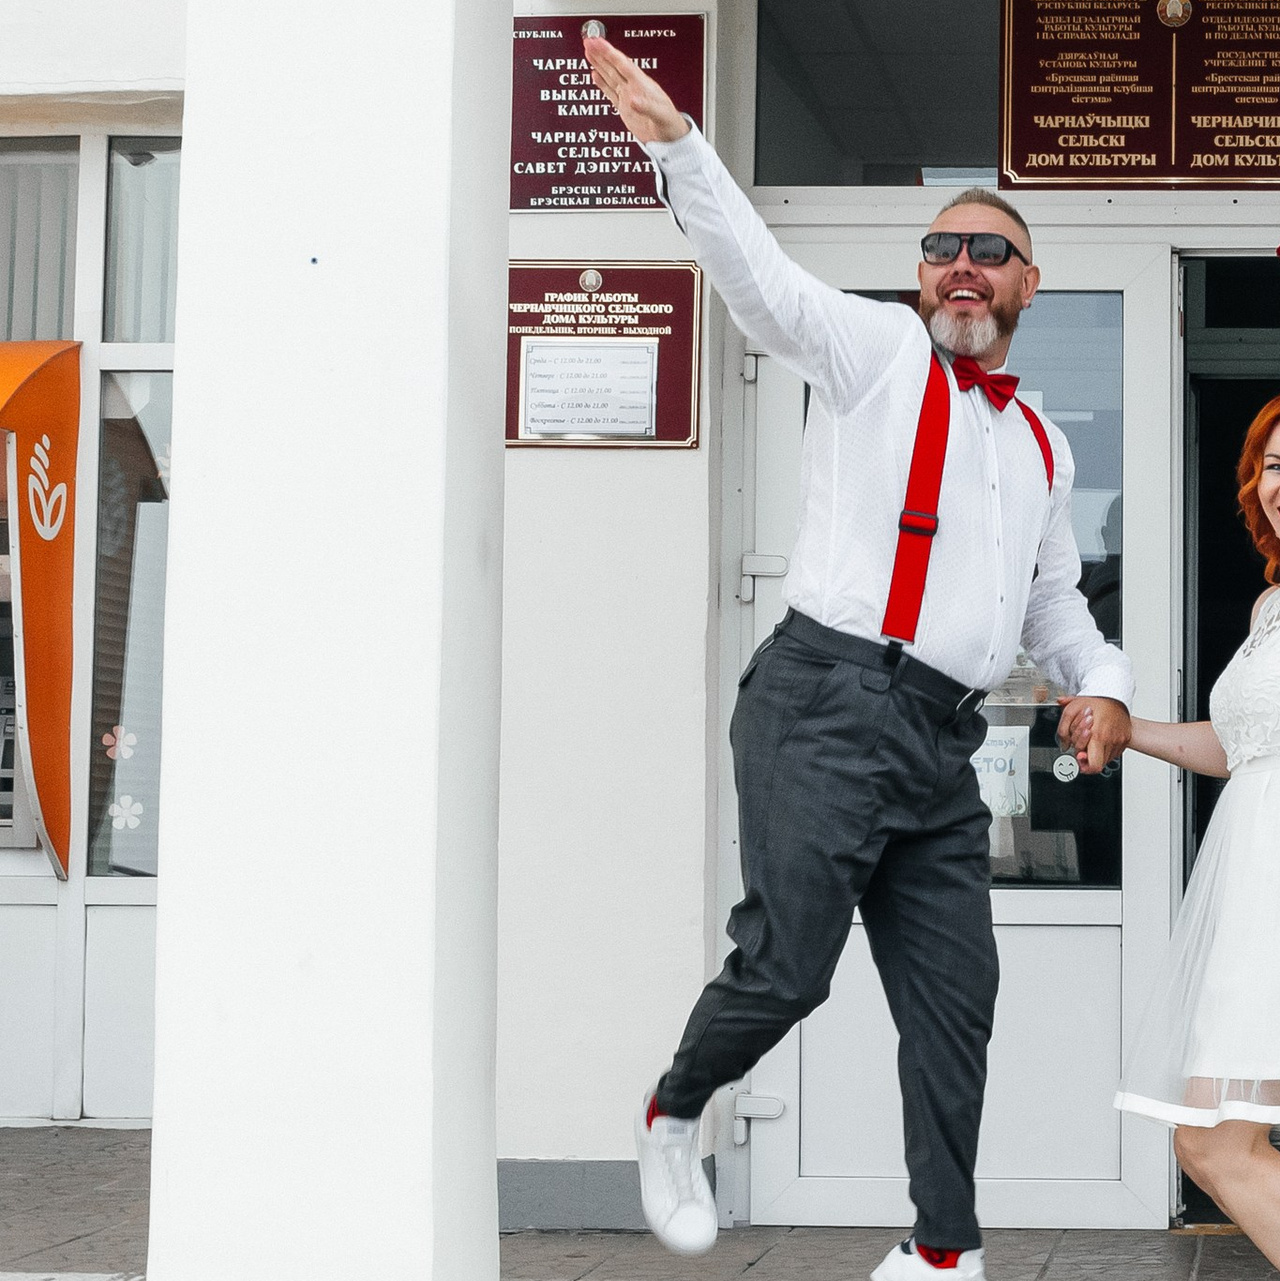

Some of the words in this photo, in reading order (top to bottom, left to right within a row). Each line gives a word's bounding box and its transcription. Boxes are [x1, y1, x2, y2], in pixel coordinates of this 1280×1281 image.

[1093, 2, 1141, 10] БЕЛАРУСЬ
[1206, 2, 1268, 10] РЕСПУБЛИКИ
[1202, 16, 1232, 24] ОТДЕЛ
[1085, 24, 1133, 32] КУЛЬТУРЫ
[513, 30, 564, 39] СПУБЛІКА
[624, 29, 677, 38] БЕЛАРУСЬ
[1042, 32, 1056, 40] ПА
[1057, 32, 1098, 40] СПРАВАХ
[1205, 32, 1212, 40] И
[1214, 32, 1228, 40] ПО
[1229, 32, 1262, 40] ДЕЛАМ
[1204, 59, 1268, 68] УЧРЕЖДЕНИЕ
[1099, 73, 1139, 84] раённая
[1205, 73, 1261, 84] «Брестская
[1113, 84, 1154, 95] клубная
[1191, 85, 1280, 95] централизованная
[1235, 95, 1279, 104] система»
[557, 104, 621, 116] КАМІТЭ
[1033, 113, 1150, 130] ЧАРНАЎЧЫЦКІ
[531, 128, 637, 144] ЧАРНАЎЧЫЦ
[1057, 134, 1126, 147] СЕЛЬСКІ
[557, 146, 630, 158] СЕЛЬСКІ
[1025, 153, 1064, 168] ДОМ
[1069, 153, 1157, 166] КУЛЬТУРЫ
[1190, 153, 1229, 168] ДОМ
[513, 161, 567, 174] САВЕТ
[574, 161, 656, 175] ДЭПУТАТ
[551, 186, 601, 195] БРЭСЦКІ
[606, 184, 636, 195] РАЁН
[530, 197, 590, 207] БРЭСЦКАЯ
[595, 196, 657, 206] ВОБЛАСЦЬ
[544, 293, 589, 303] ГРАФИК
[591, 293, 639, 303] РАБОТЫ
[509, 303, 605, 314] ЧЕРНАВЧИЦКОГО
[608, 304, 674, 314] СЕЛЬСКОГО
[542, 314, 576, 325] ДОМА
[578, 314, 639, 325] КУЛЬТУРЫ
[577, 326, 617, 335] ВТОРНИК
[623, 325, 672, 335] ВЫХОДНОЙ
[971, 757, 1016, 777] ЕТО!
